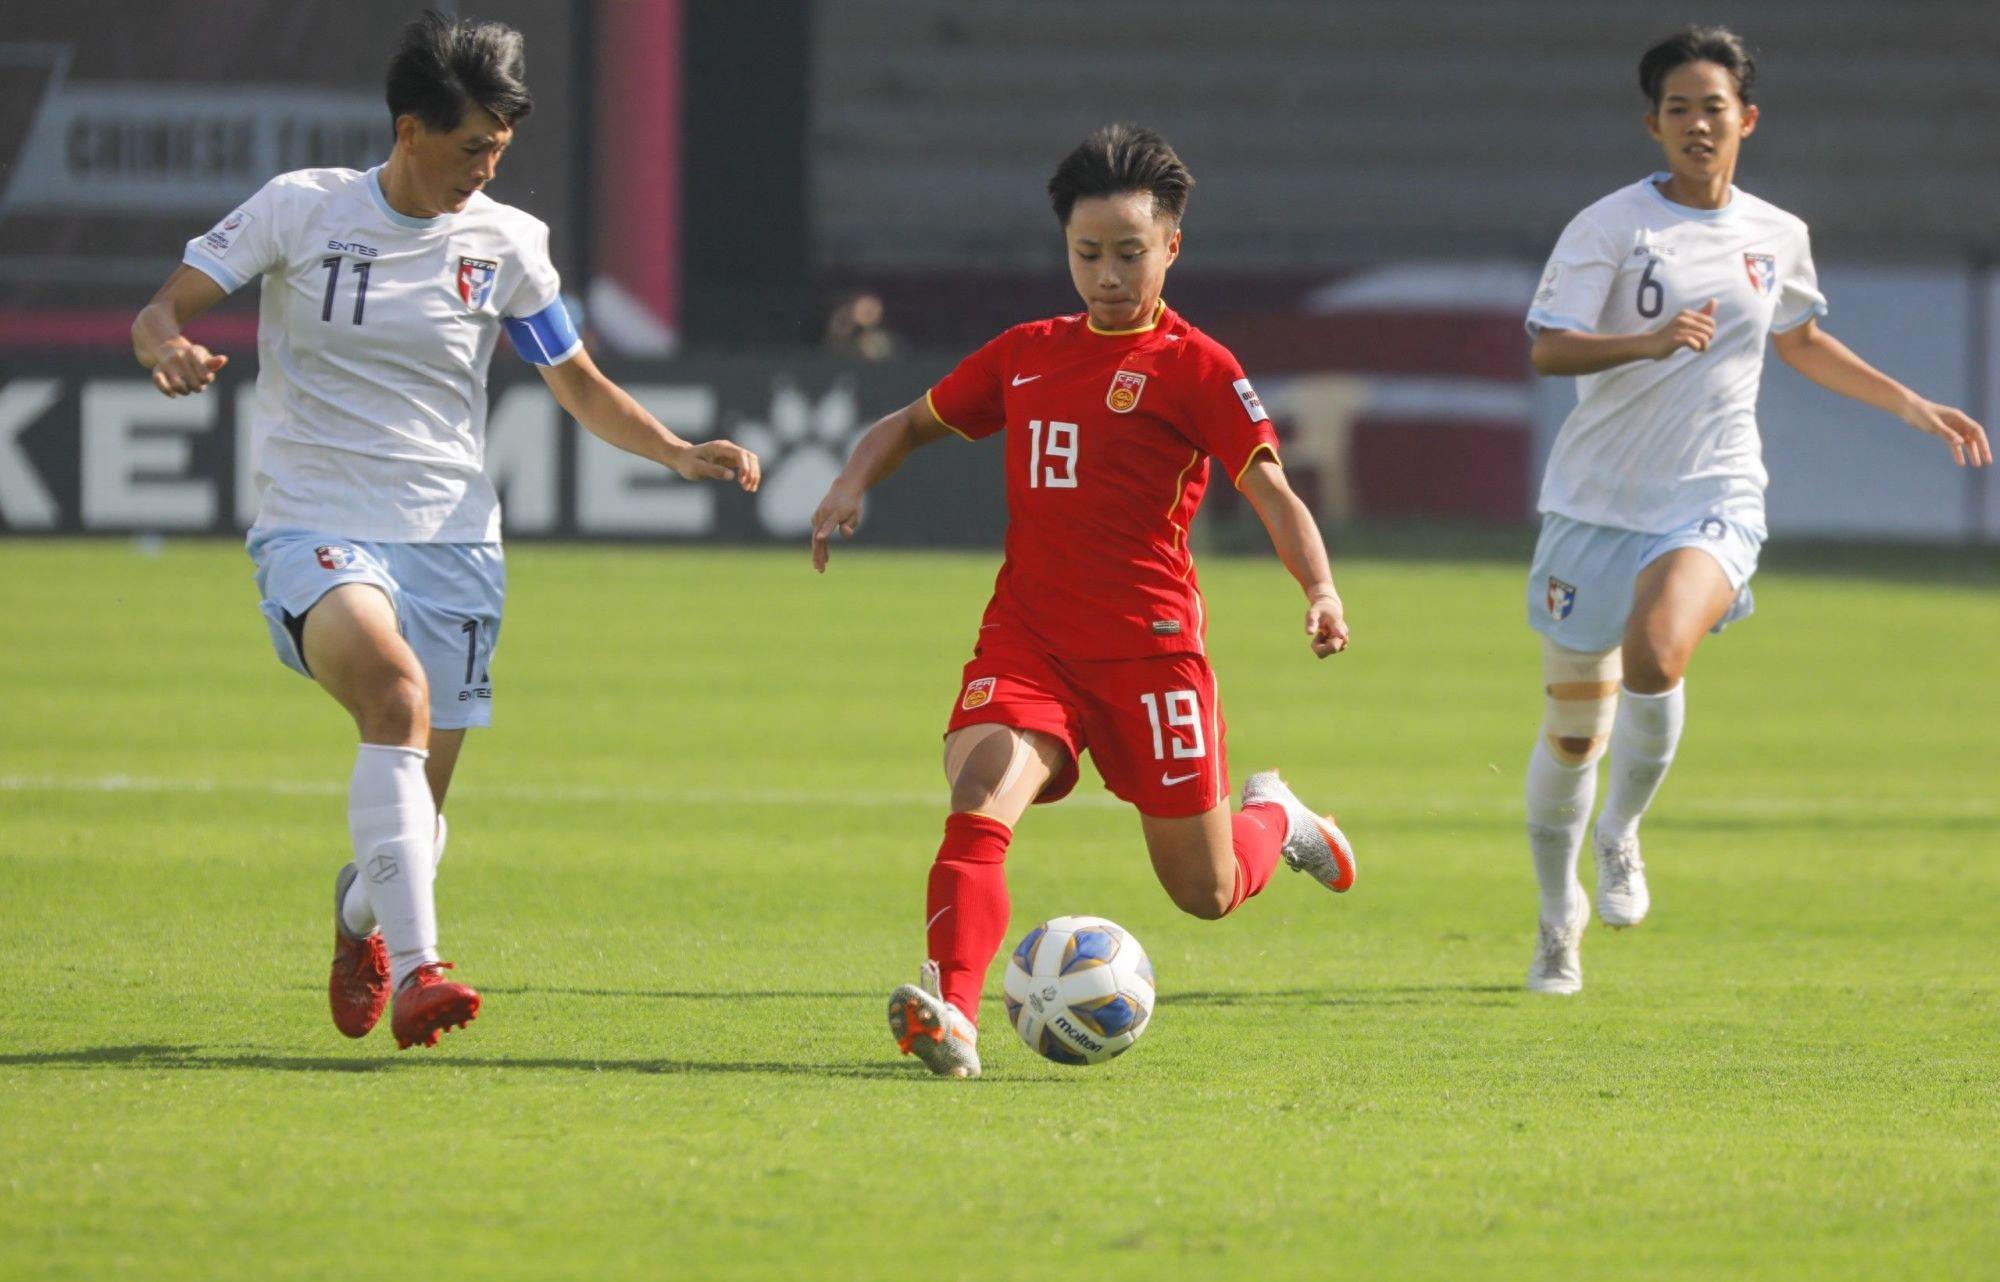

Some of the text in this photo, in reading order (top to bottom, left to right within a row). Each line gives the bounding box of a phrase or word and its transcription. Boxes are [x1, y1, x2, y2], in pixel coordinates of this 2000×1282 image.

[278, 113, 394, 172] TAIP
[328, 240, 378, 257] ENTES
[322, 256, 372, 325] 11
[1636, 257, 1664, 319] 6
[0, 379, 714, 533] KEE
[1029, 420, 1078, 488] 19
[1140, 690, 1206, 760] 19
[1055, 1017, 1104, 1053] molten
